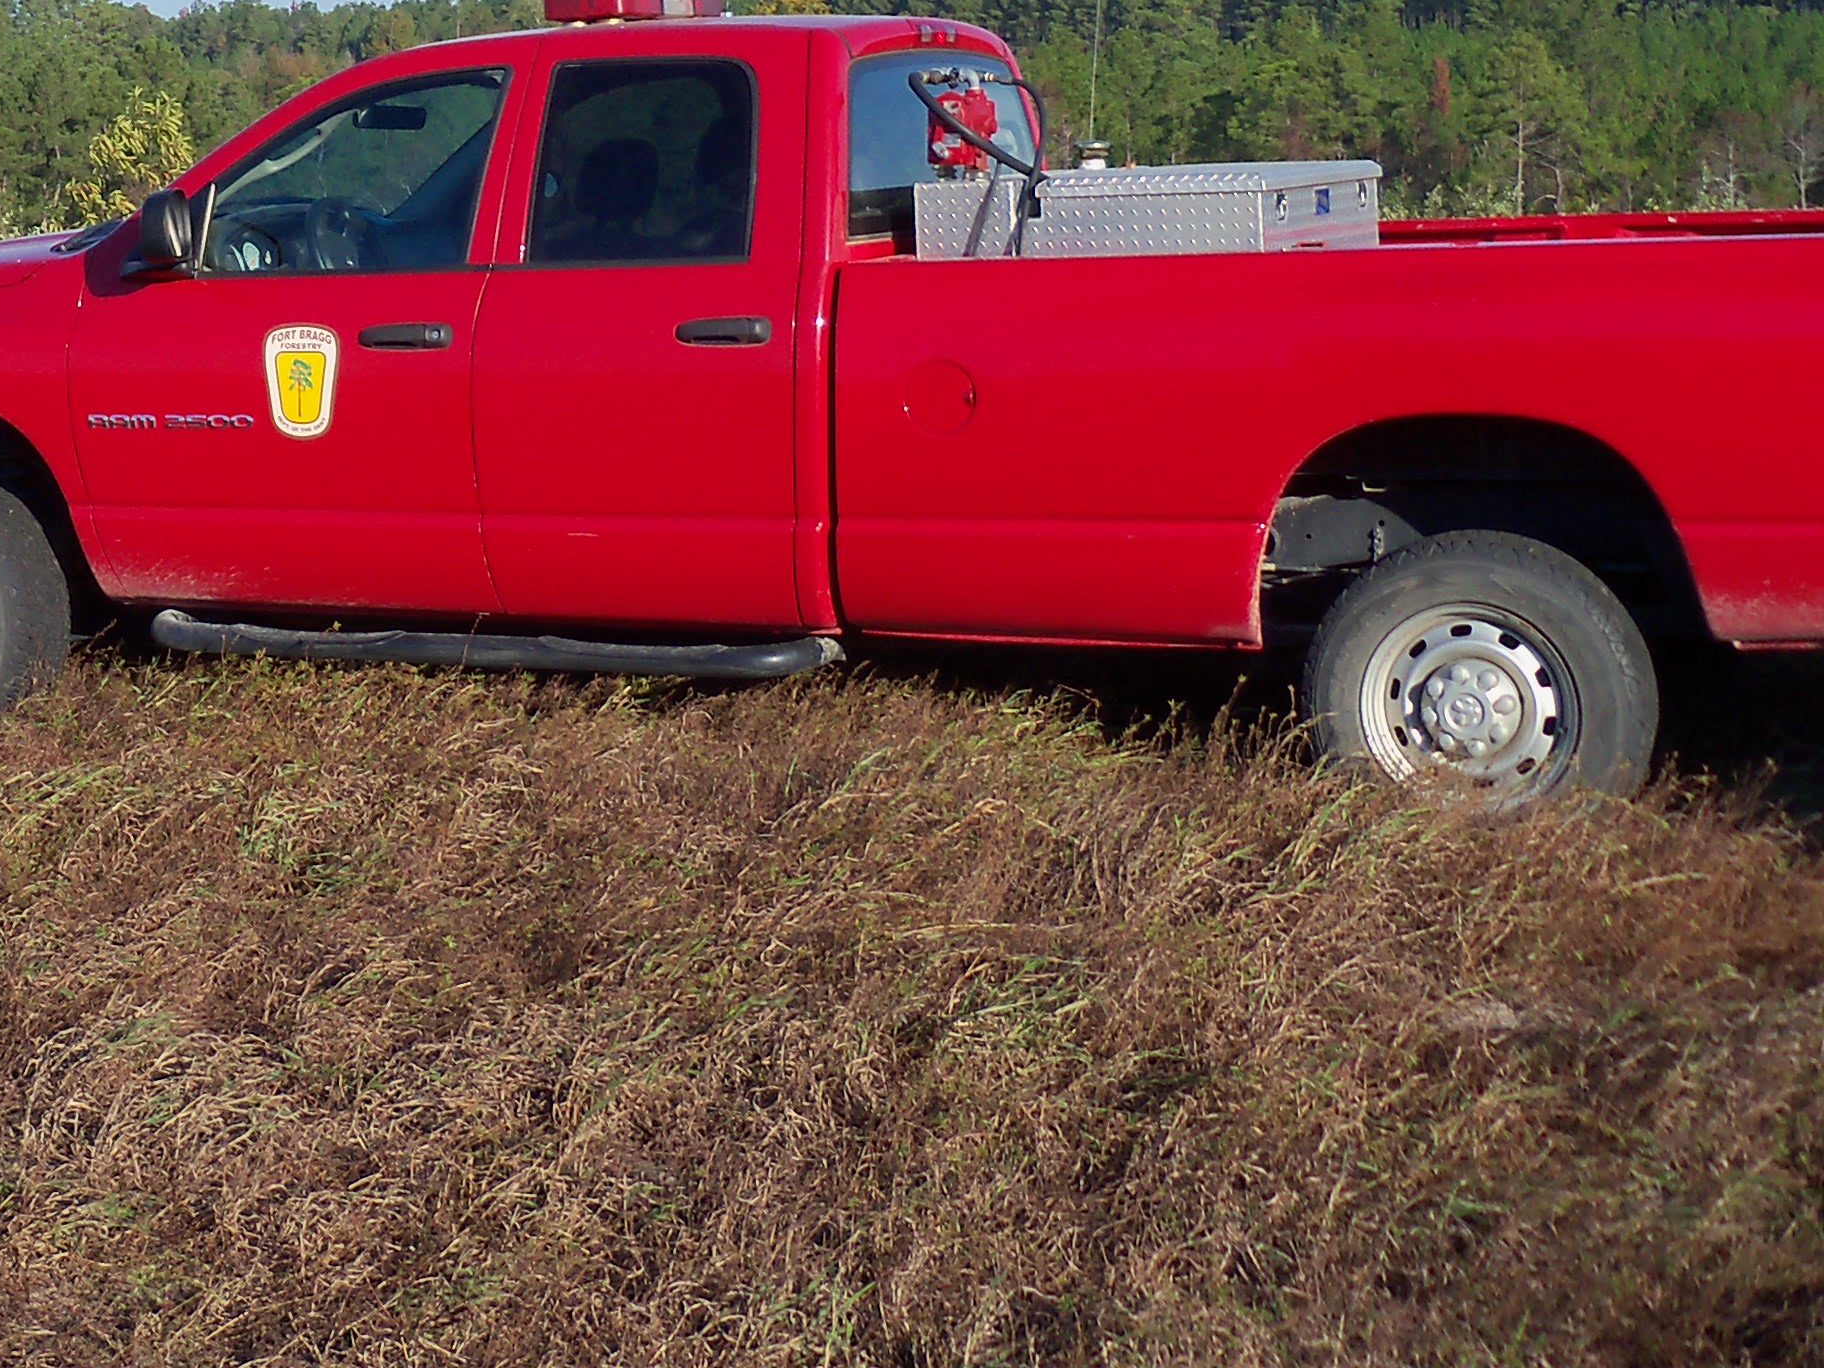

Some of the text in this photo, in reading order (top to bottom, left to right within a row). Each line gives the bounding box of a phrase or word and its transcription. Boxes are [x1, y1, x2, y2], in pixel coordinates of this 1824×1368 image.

[271, 330, 332, 345] FORT BRAGG
[280, 342, 323, 350] FORESTRY
[87, 413, 254, 430] RAM 2500
